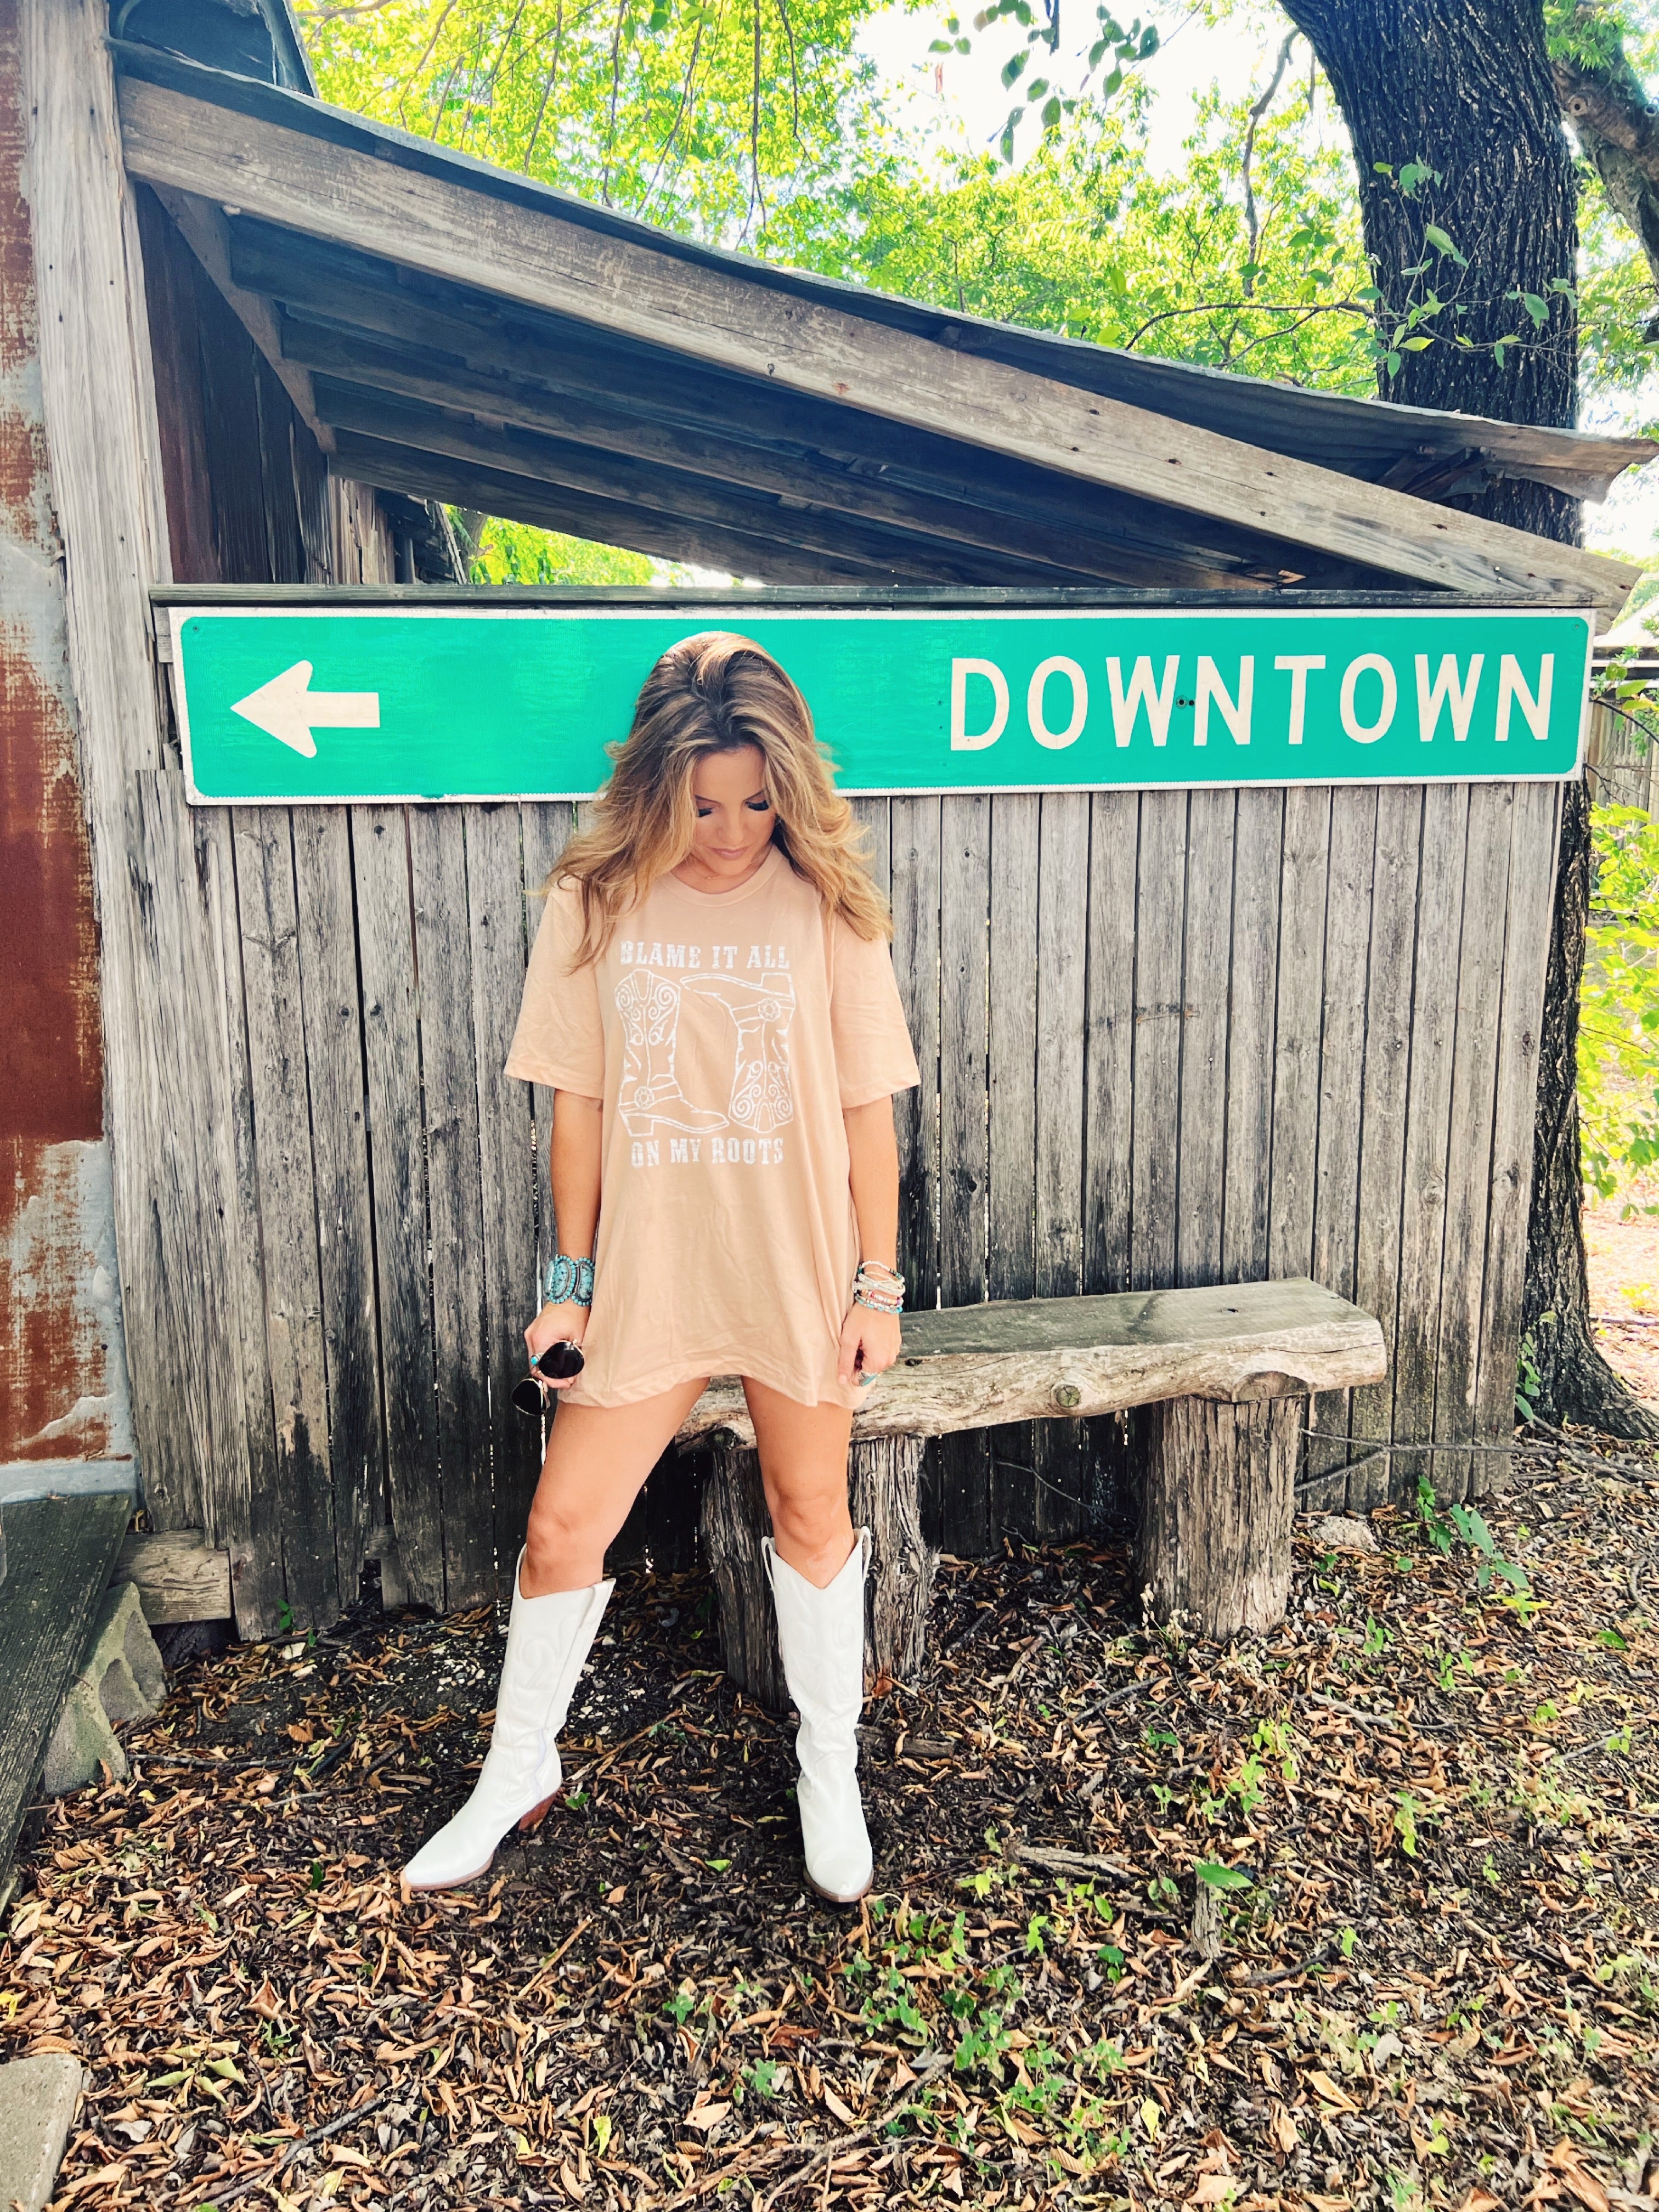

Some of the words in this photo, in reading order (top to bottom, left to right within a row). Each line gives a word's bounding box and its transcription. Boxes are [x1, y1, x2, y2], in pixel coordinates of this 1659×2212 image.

[950, 653, 1555, 751] DOWNTOWN
[620, 940, 701, 968] BLAME
[712, 946, 738, 969] IT
[747, 945, 789, 969] ALL
[631, 1140, 660, 1167] ON
[669, 1138, 702, 1164] MY
[711, 1137, 783, 1165] ROOTS
